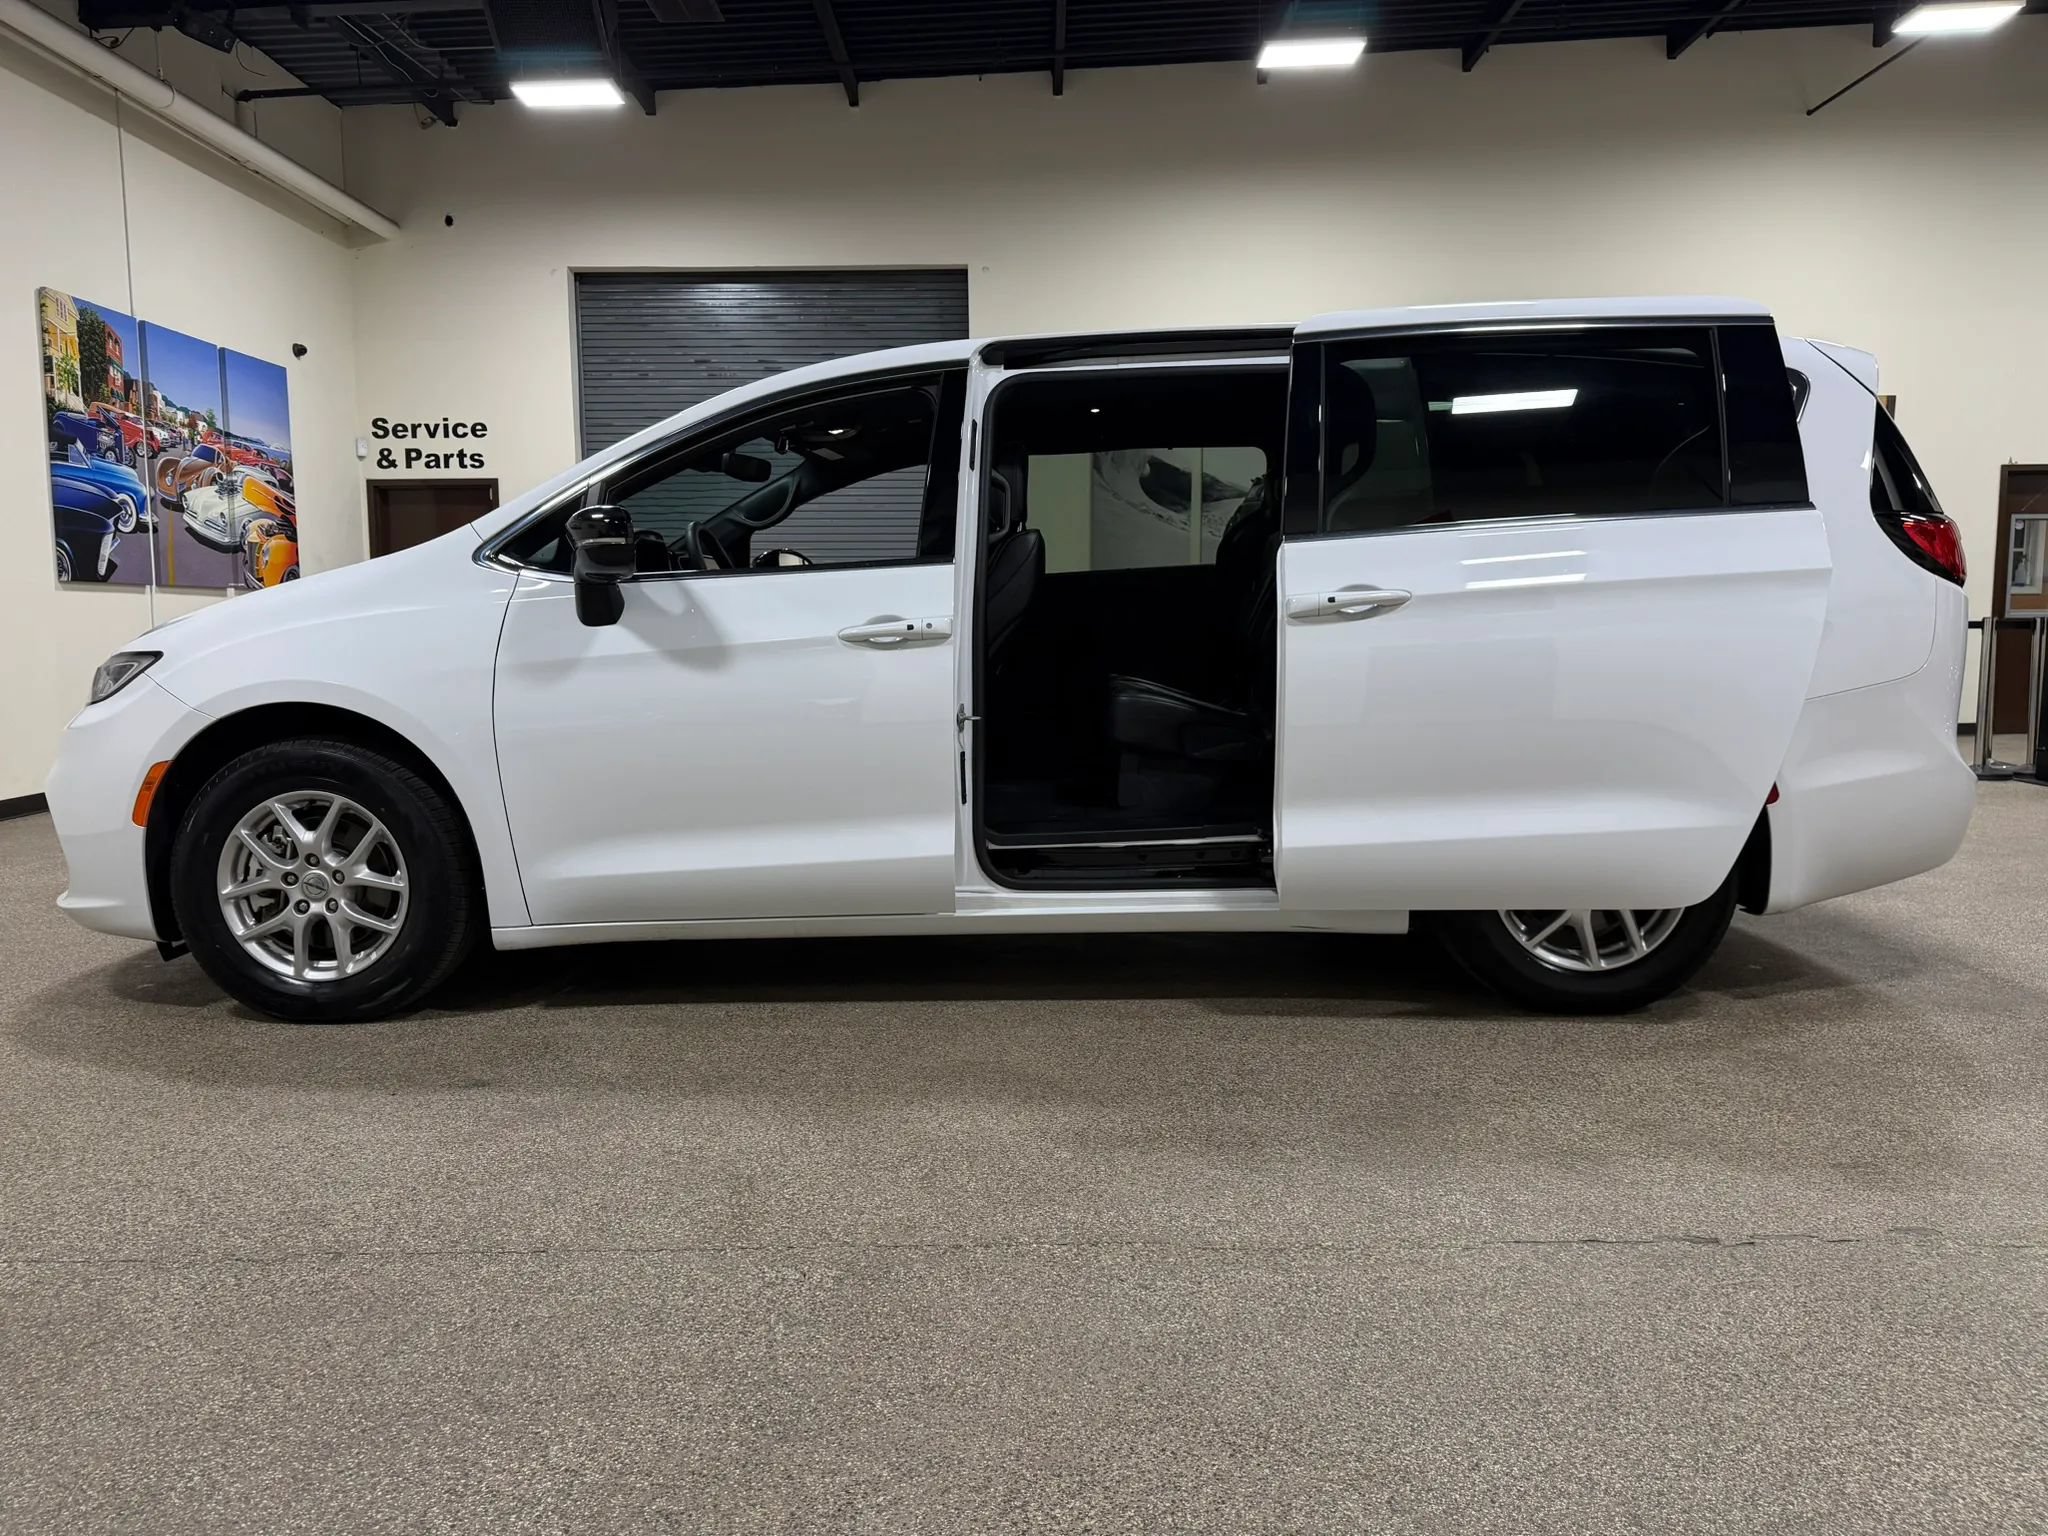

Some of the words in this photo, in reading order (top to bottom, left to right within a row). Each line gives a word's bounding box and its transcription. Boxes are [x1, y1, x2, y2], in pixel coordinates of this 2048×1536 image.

[371, 417, 488, 439] Service
[376, 447, 398, 469] &
[404, 447, 485, 469] Parts
